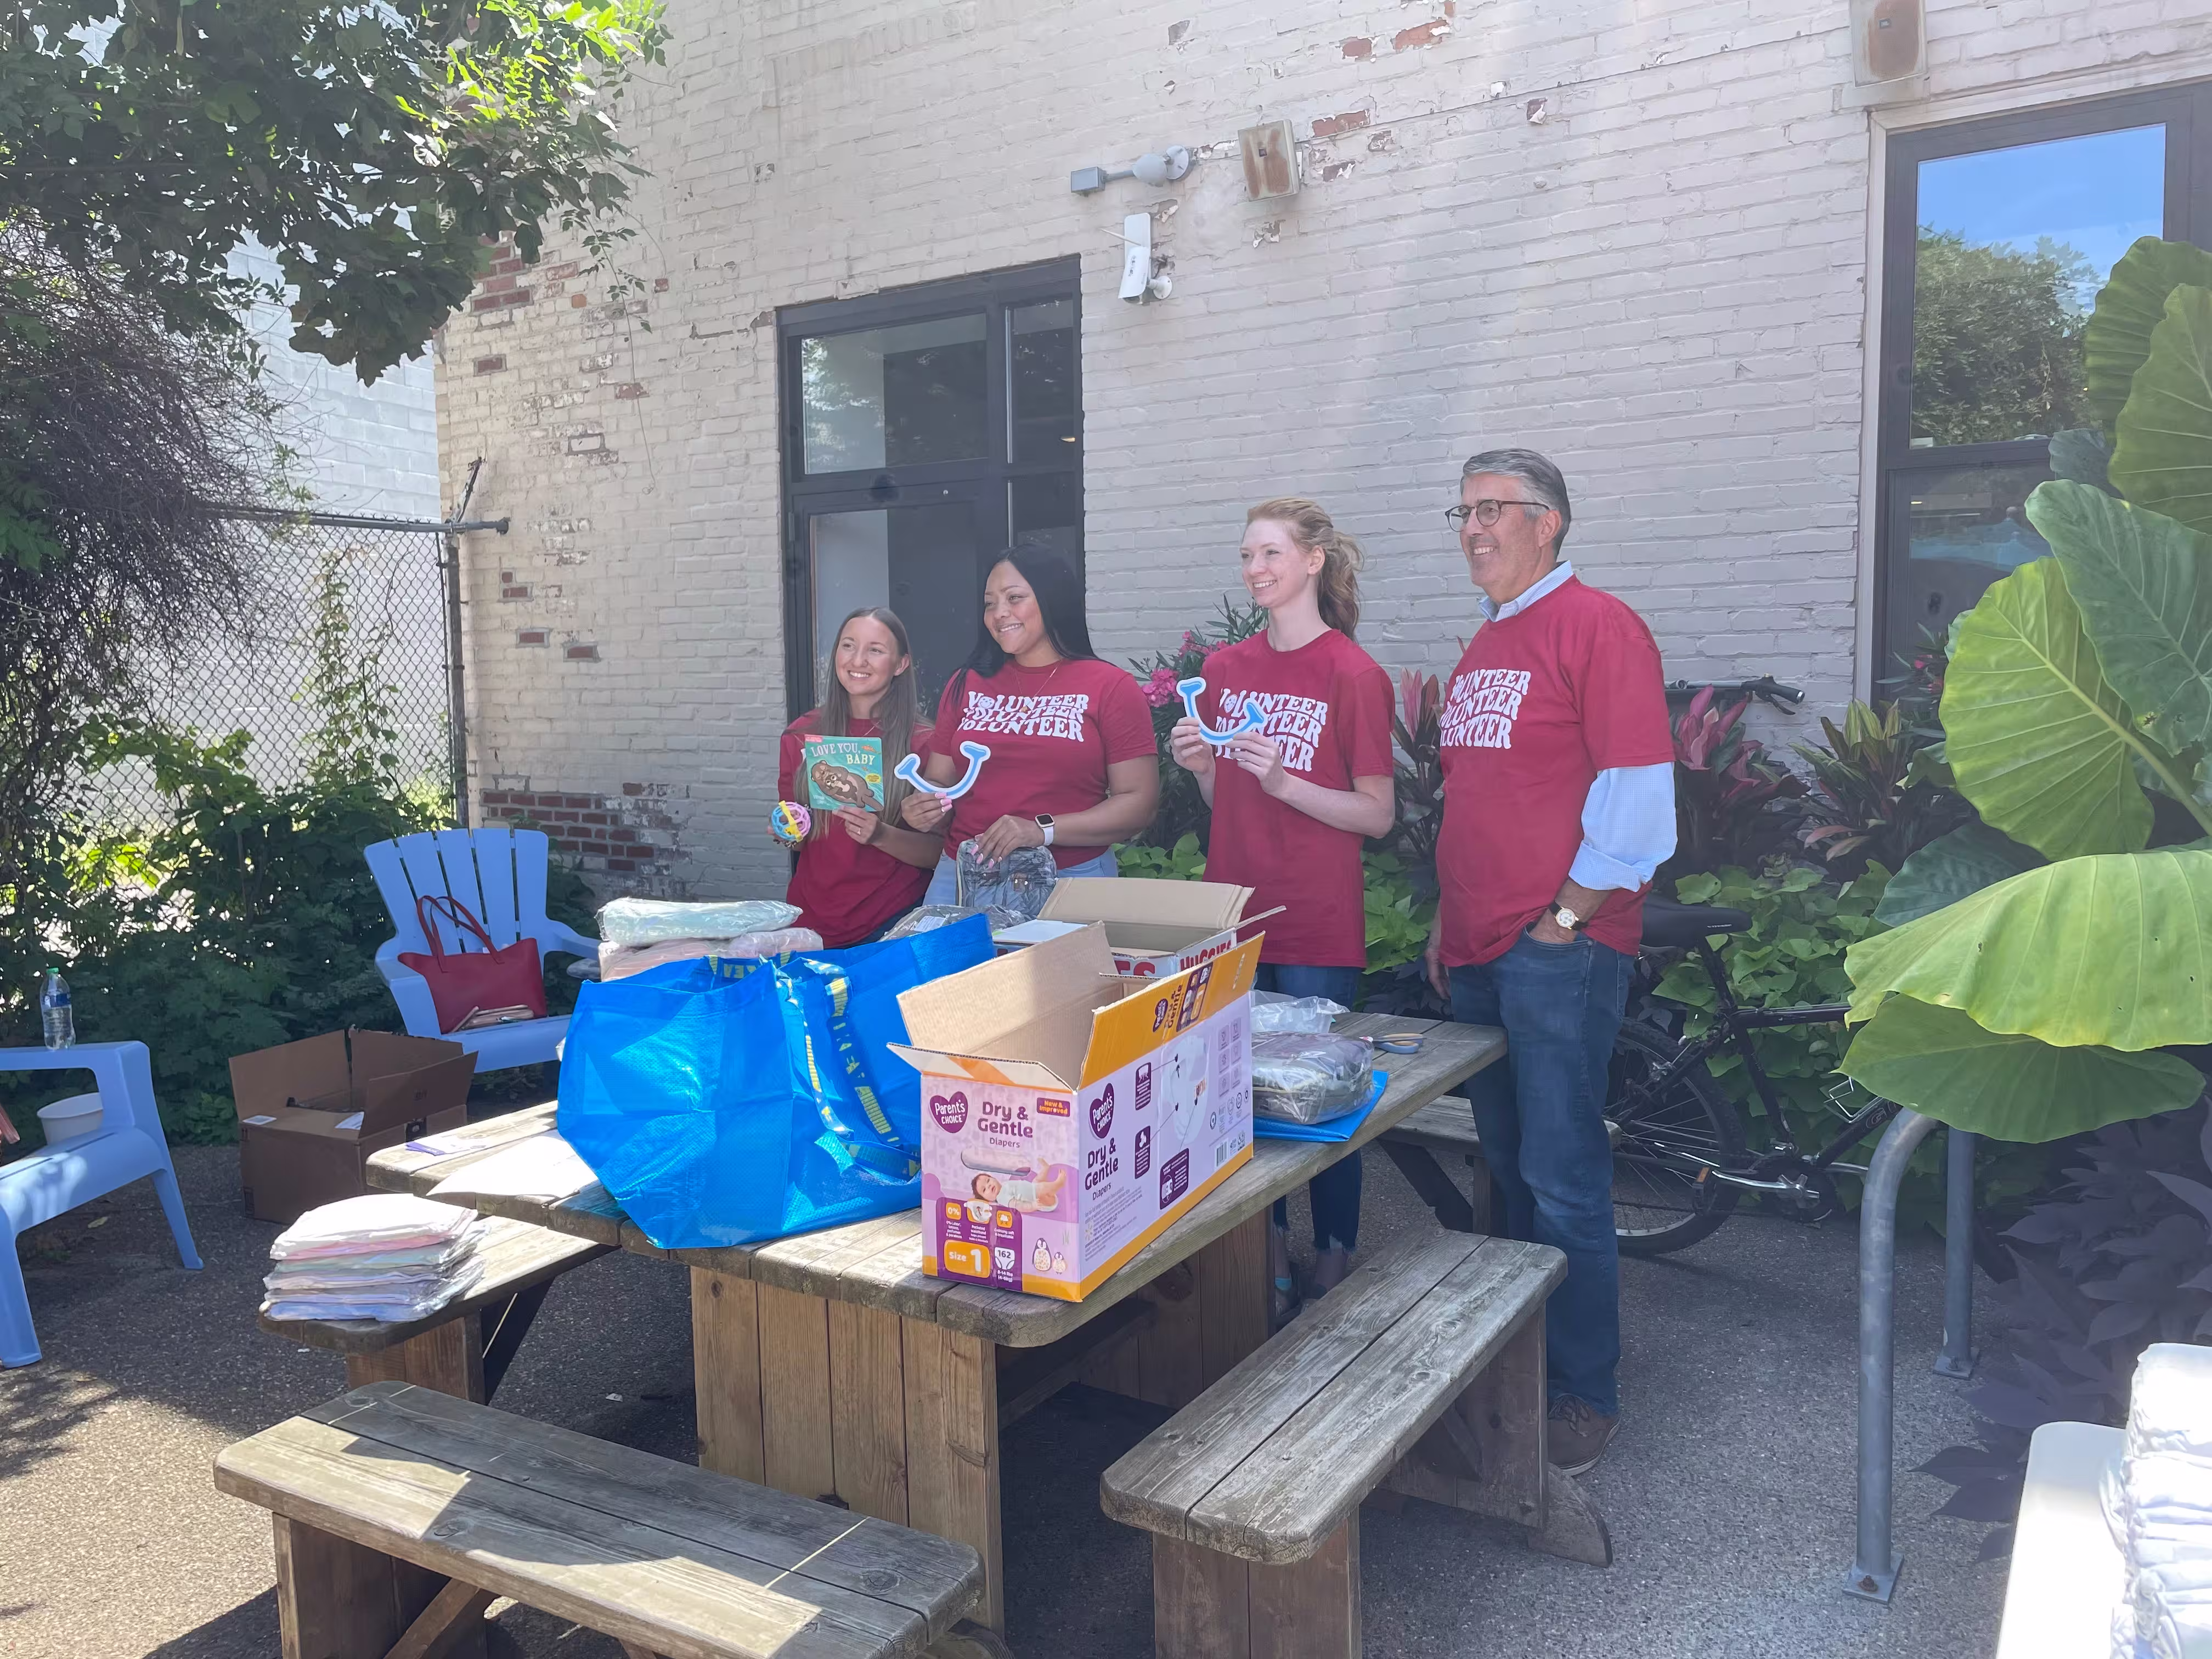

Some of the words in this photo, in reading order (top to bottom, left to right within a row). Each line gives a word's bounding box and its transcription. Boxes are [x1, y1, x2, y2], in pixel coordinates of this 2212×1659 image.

[968, 691, 1090, 713] VOLUNTEER
[957, 716, 1085, 742] VOLUNTEER
[810, 743, 836, 757] LOVE
[845, 754, 876, 765] BABY
[934, 1099, 966, 1115] Parent's
[982, 1101, 1012, 1121] Dry
[1017, 1106, 1029, 1121] &
[1039, 1105, 1068, 1115] Improved
[1093, 1092, 1113, 1124] Parent's
[941, 1114, 963, 1125] CHOICE
[978, 1118, 1033, 1138] Gentle
[1097, 1110, 1111, 1132] CHOICE
[990, 1137, 1020, 1148] Diapers
[1087, 1144, 1106, 1169] Dry
[1109, 1137, 1116, 1155] &
[1085, 1157, 1119, 1190] Gentle
[1092, 1182, 1111, 1201] Diapers
[947, 1206, 960, 1216] 0%
[949, 1251, 967, 1261] Size
[970, 1249, 981, 1272] 1
[997, 1250, 1011, 1259] 162
